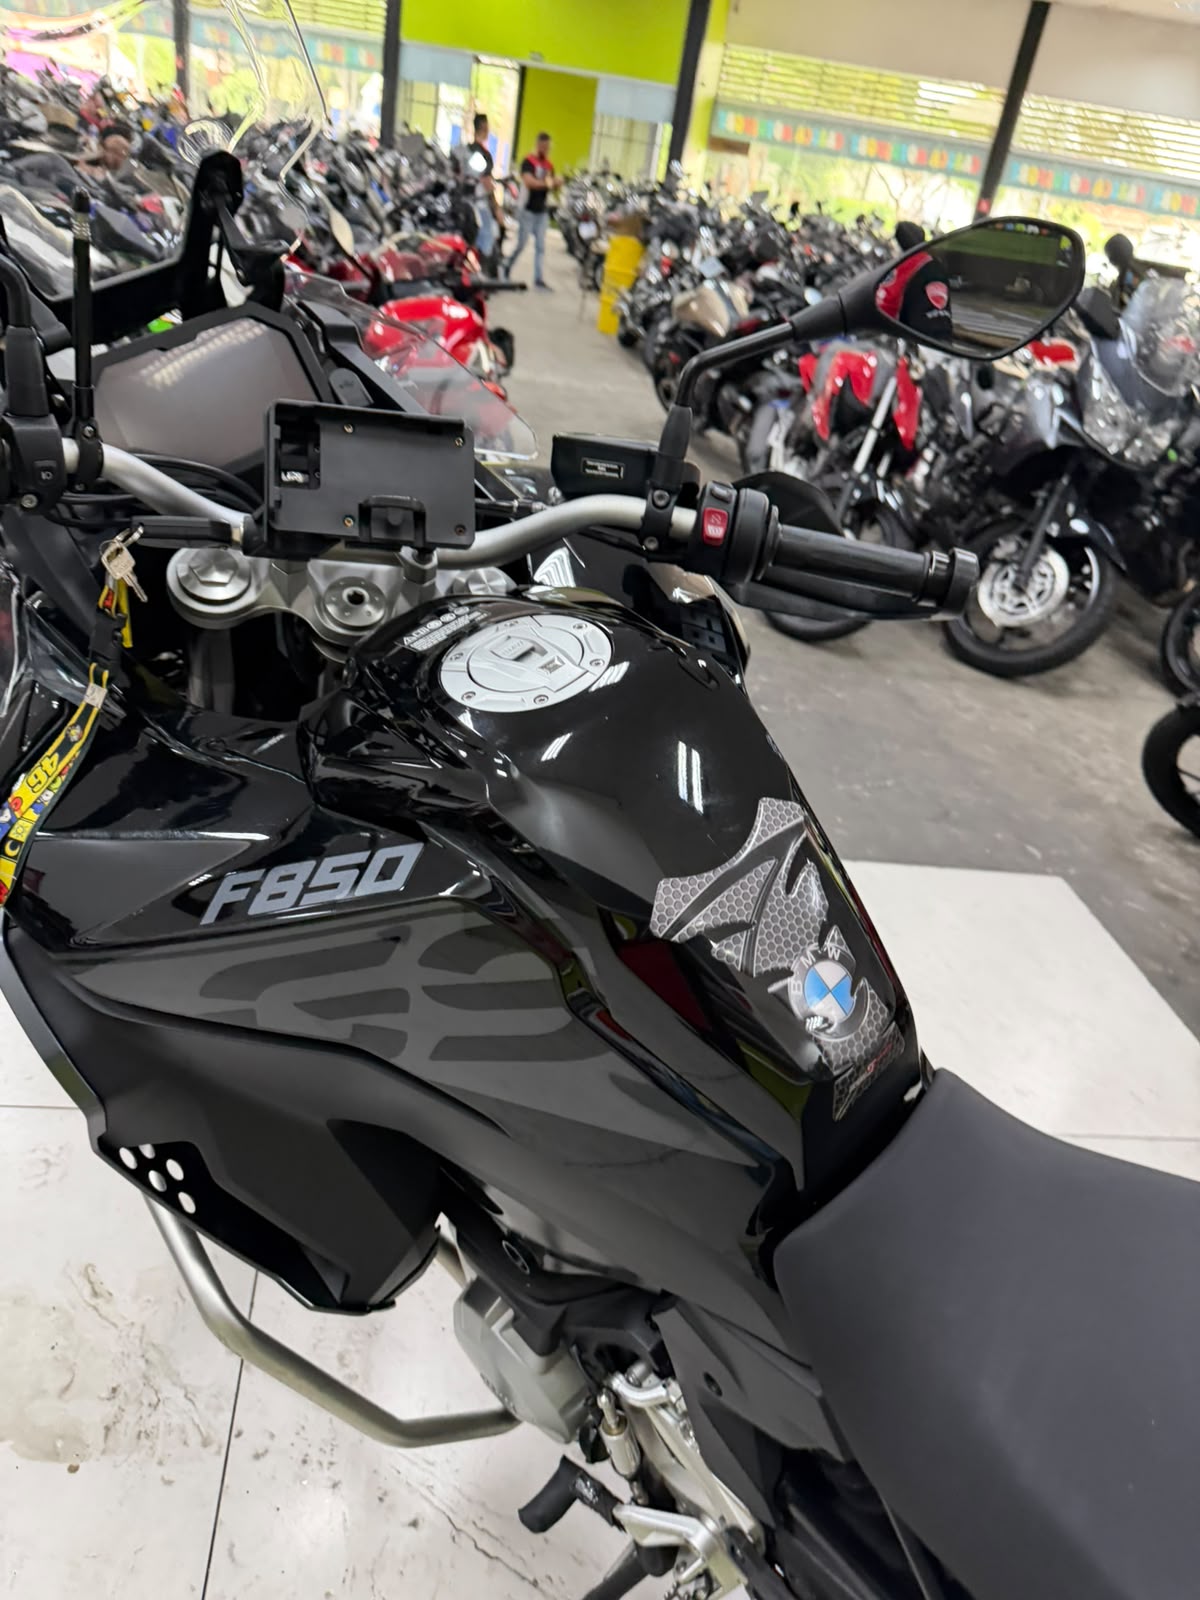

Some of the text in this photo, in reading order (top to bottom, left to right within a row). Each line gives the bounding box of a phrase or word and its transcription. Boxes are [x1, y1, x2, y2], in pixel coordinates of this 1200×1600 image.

[27, 753, 60, 793] 46
[200, 842, 424, 925] F850
[791, 947, 841, 993] BMW
